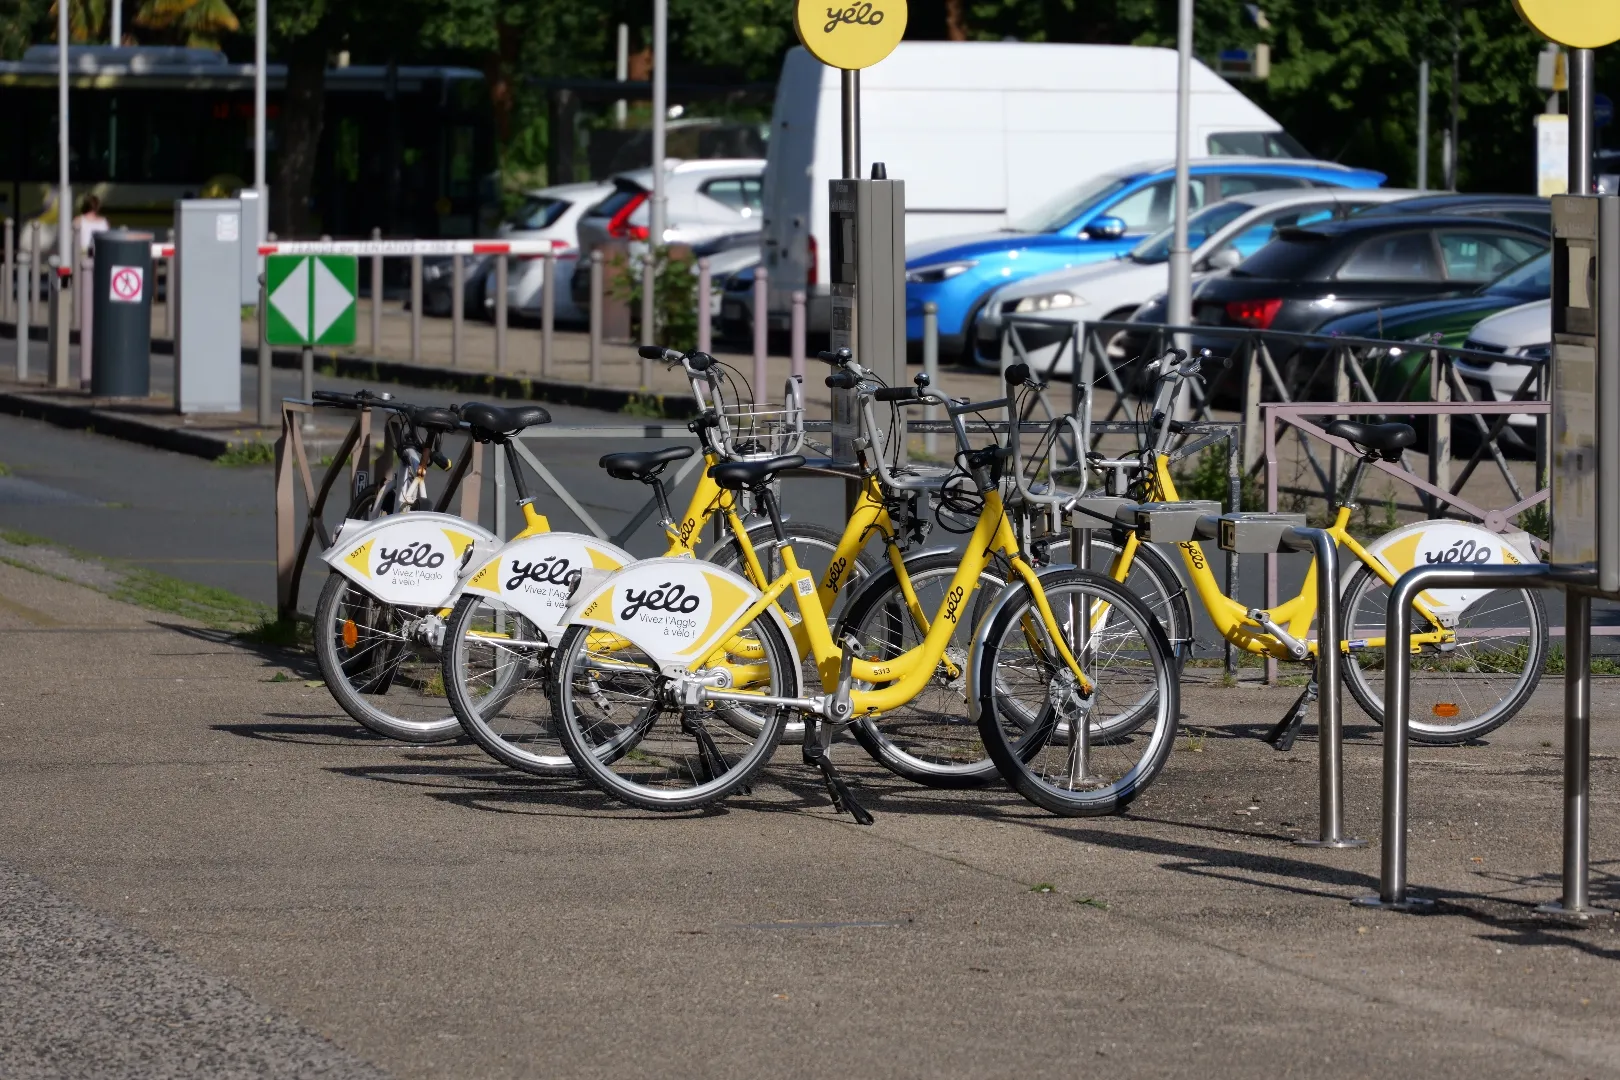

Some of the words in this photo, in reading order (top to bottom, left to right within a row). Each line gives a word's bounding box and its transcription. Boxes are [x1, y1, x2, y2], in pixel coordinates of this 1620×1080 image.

[823, 1, 885, 33] yélo
[376, 541, 445, 576] yélo
[392, 568, 414, 578] Vivez
[398, 577, 415, 586] vélo
[826, 557, 847, 594] yélo
[524, 584, 546, 596] Vivez
[620, 582, 700, 621] yélo
[943, 585, 964, 624] yélo
[639, 613, 662, 624] Vivez
[665, 615, 697, 629] l'Agglo
[663, 627, 670, 636] à
[671, 628, 690, 638] vélo
